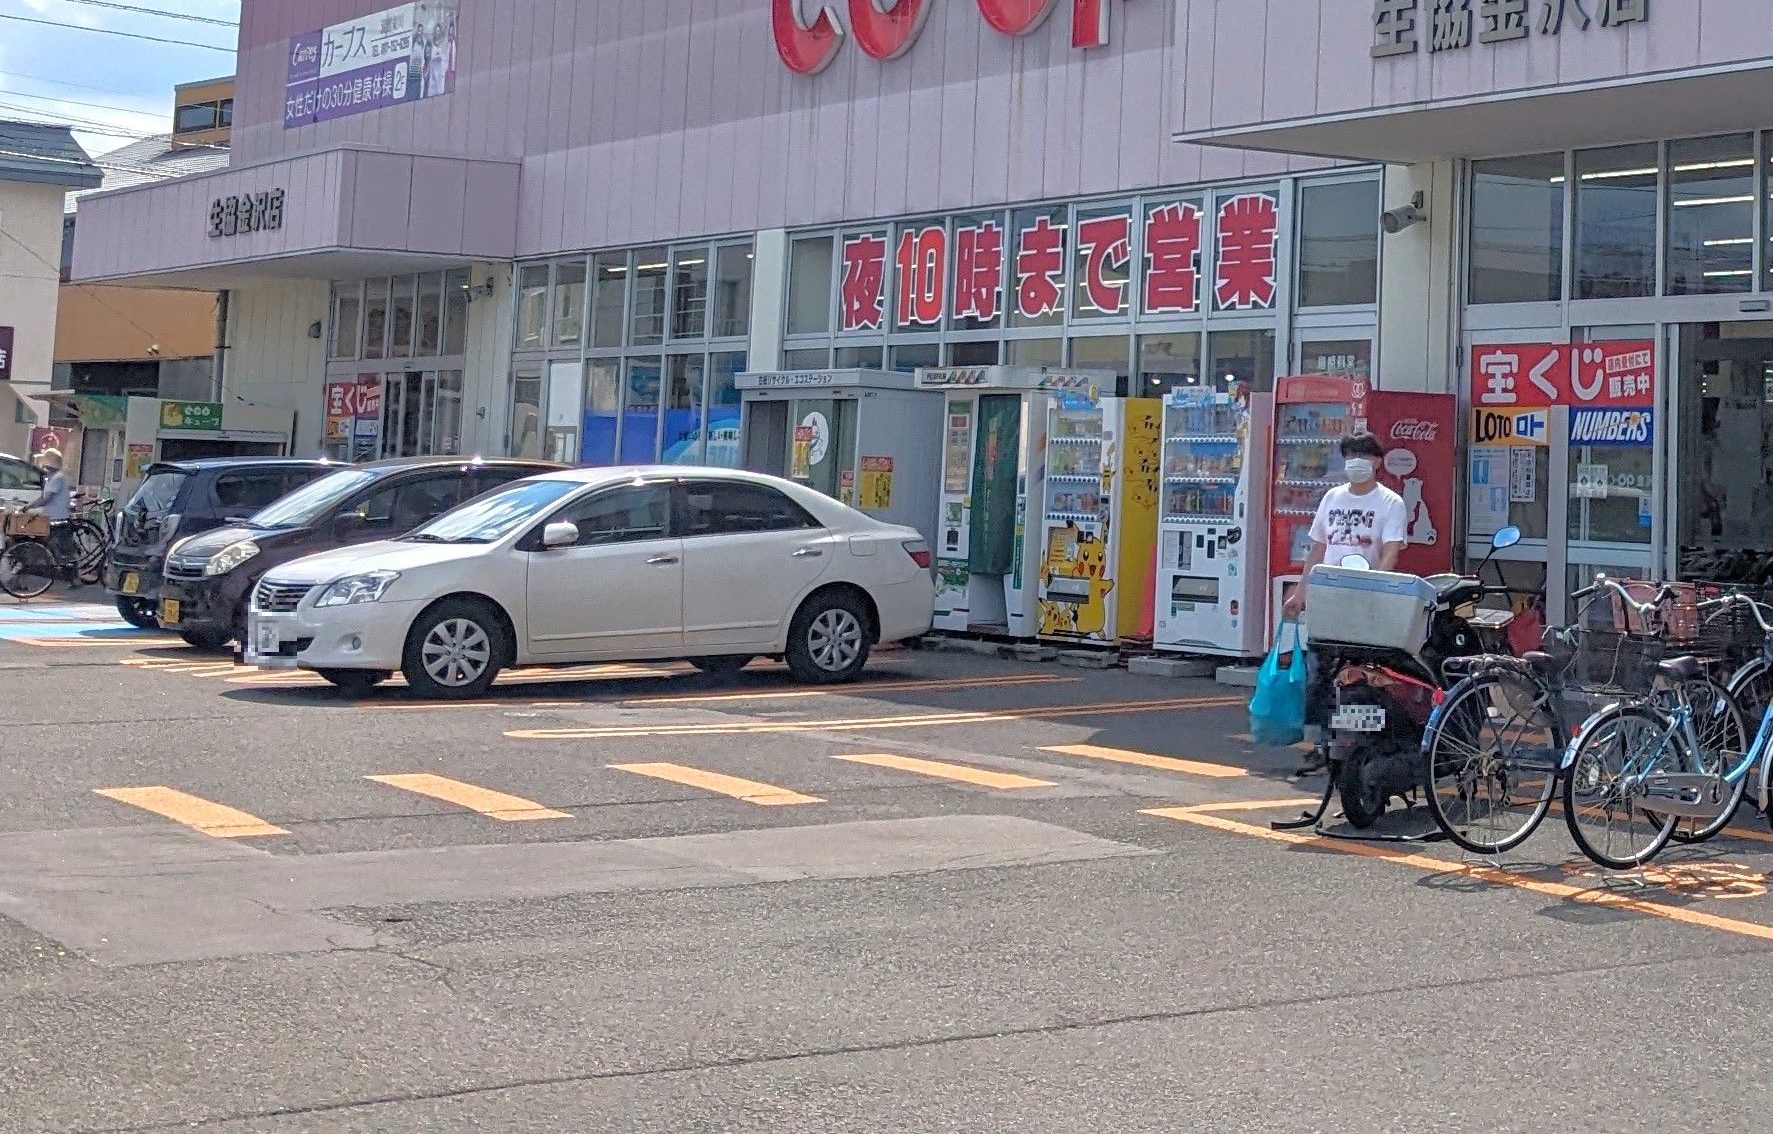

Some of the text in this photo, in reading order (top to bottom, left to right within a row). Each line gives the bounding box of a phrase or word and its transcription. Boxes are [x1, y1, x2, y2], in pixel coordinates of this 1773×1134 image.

[842, 194, 1279, 330] 夜10時まで営業
[1480, 348, 1604, 404] 宝くじ
[1608, 372, 1650, 399] 販売中
[1571, 411, 1652, 442] NUMBERS
